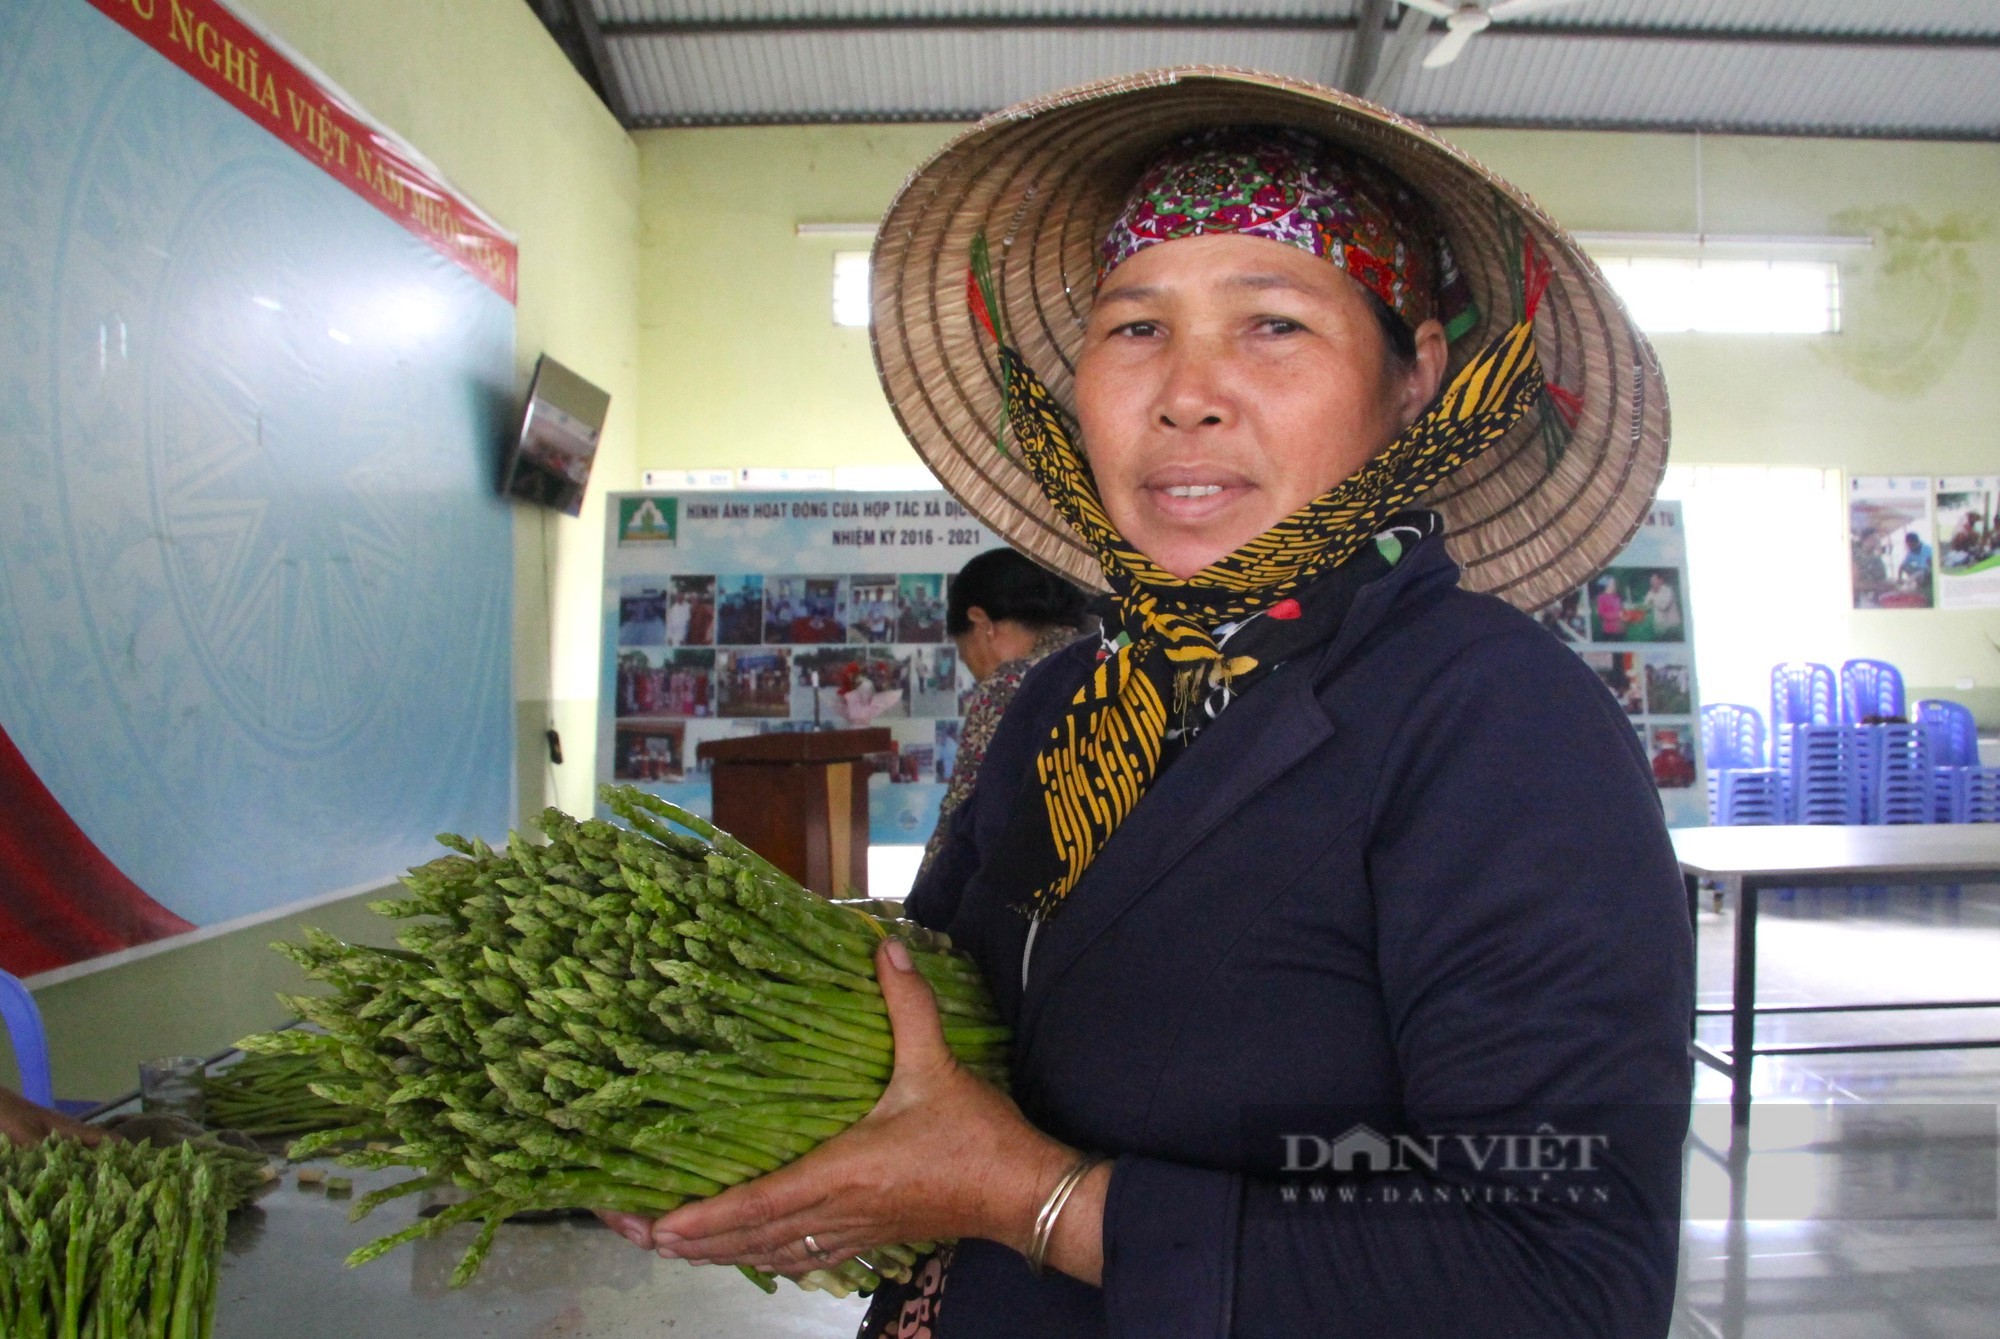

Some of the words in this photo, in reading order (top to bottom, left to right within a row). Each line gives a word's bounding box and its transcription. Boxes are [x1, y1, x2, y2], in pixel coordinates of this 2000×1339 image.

[167, 0, 280, 117] NGHĨA
[286, 88, 351, 168] VIỆT
[896, 499, 919, 517] TÁC
[832, 526, 875, 548] NHIỆM
[900, 529, 934, 546] 2016
[948, 529, 980, 546] 2021
